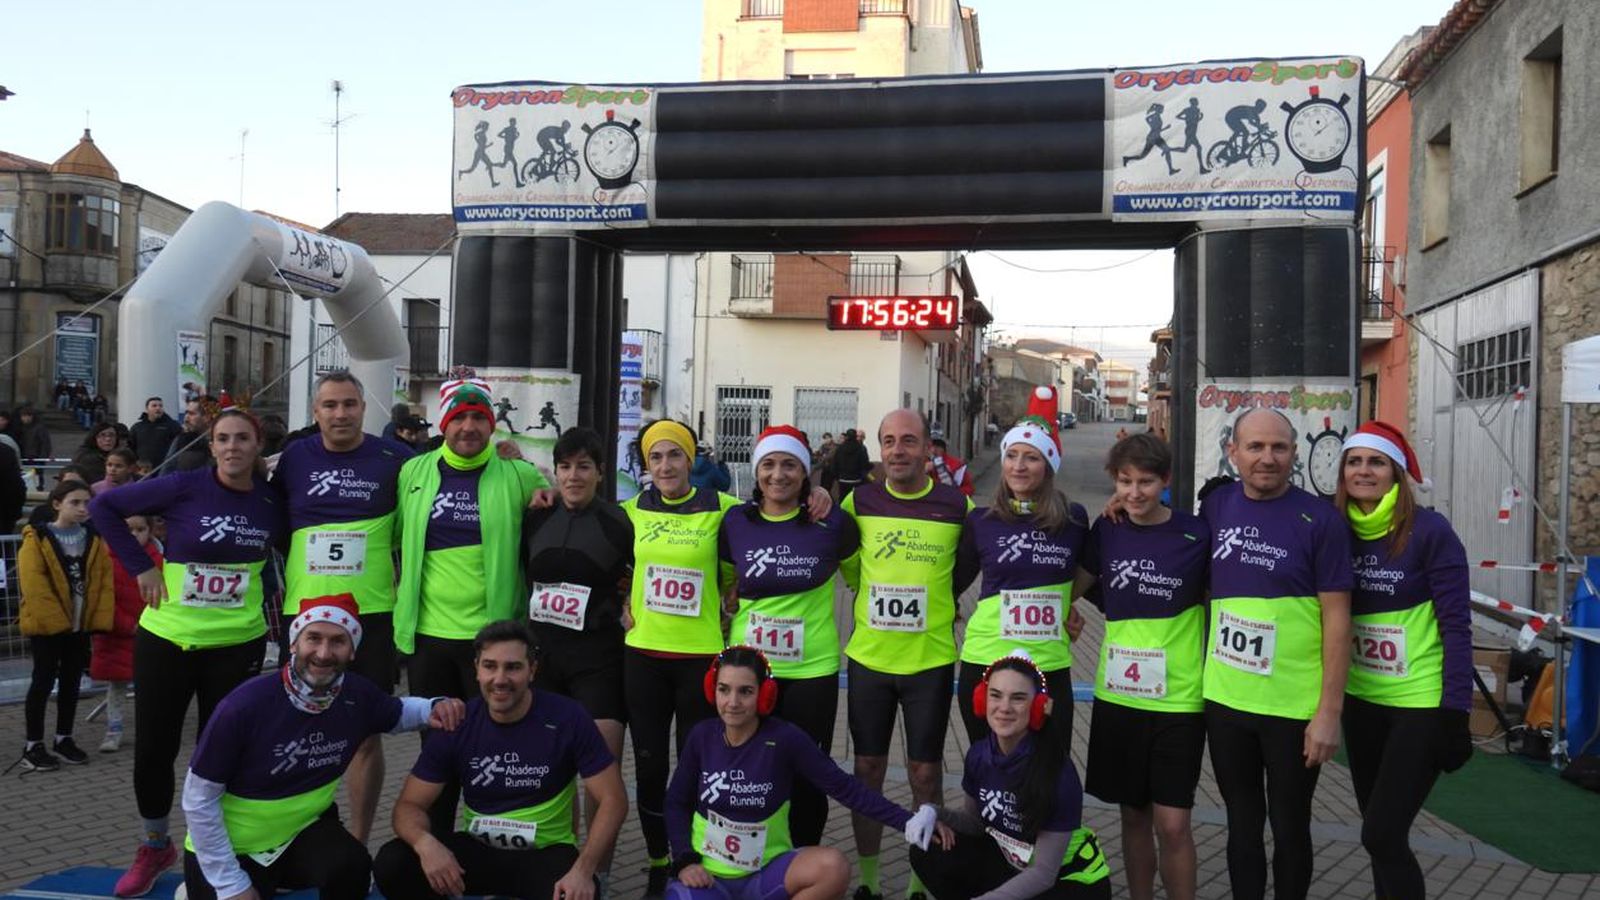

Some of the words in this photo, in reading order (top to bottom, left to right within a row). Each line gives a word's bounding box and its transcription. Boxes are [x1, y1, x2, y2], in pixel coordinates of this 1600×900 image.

[1130, 191, 1341, 210] www.orycronsport.com
[464, 206, 632, 221] www.orycronsport.com
[842, 299, 953, 326] 17:56:24
[340, 479, 379, 491] Abadengo
[339, 489, 370, 501] Running
[328, 543, 343, 562] 5
[1242, 539, 1288, 559] Abadengo
[777, 555, 820, 567] Abadengo
[905, 552, 937, 566] Running
[1032, 554, 1066, 569] Running
[1239, 552, 1276, 571] Running
[777, 567, 812, 579] Running
[1139, 571, 1183, 588] Abadengo
[1361, 567, 1405, 583] Abadengo
[194, 575, 242, 594] 107
[651, 578, 696, 601] 109
[1138, 584, 1173, 600] Running
[538, 592, 580, 616] 102
[875, 597, 920, 618] 104
[1009, 605, 1056, 626] 108
[752, 626, 794, 649] 111
[1220, 626, 1264, 657] 101
[1124, 662, 1141, 683] 4
[505, 764, 549, 777] Abadengo
[505, 777, 541, 789] Running
[730, 782, 773, 795] Abadengo
[729, 795, 766, 808] Running
[725, 835, 741, 853] 6
